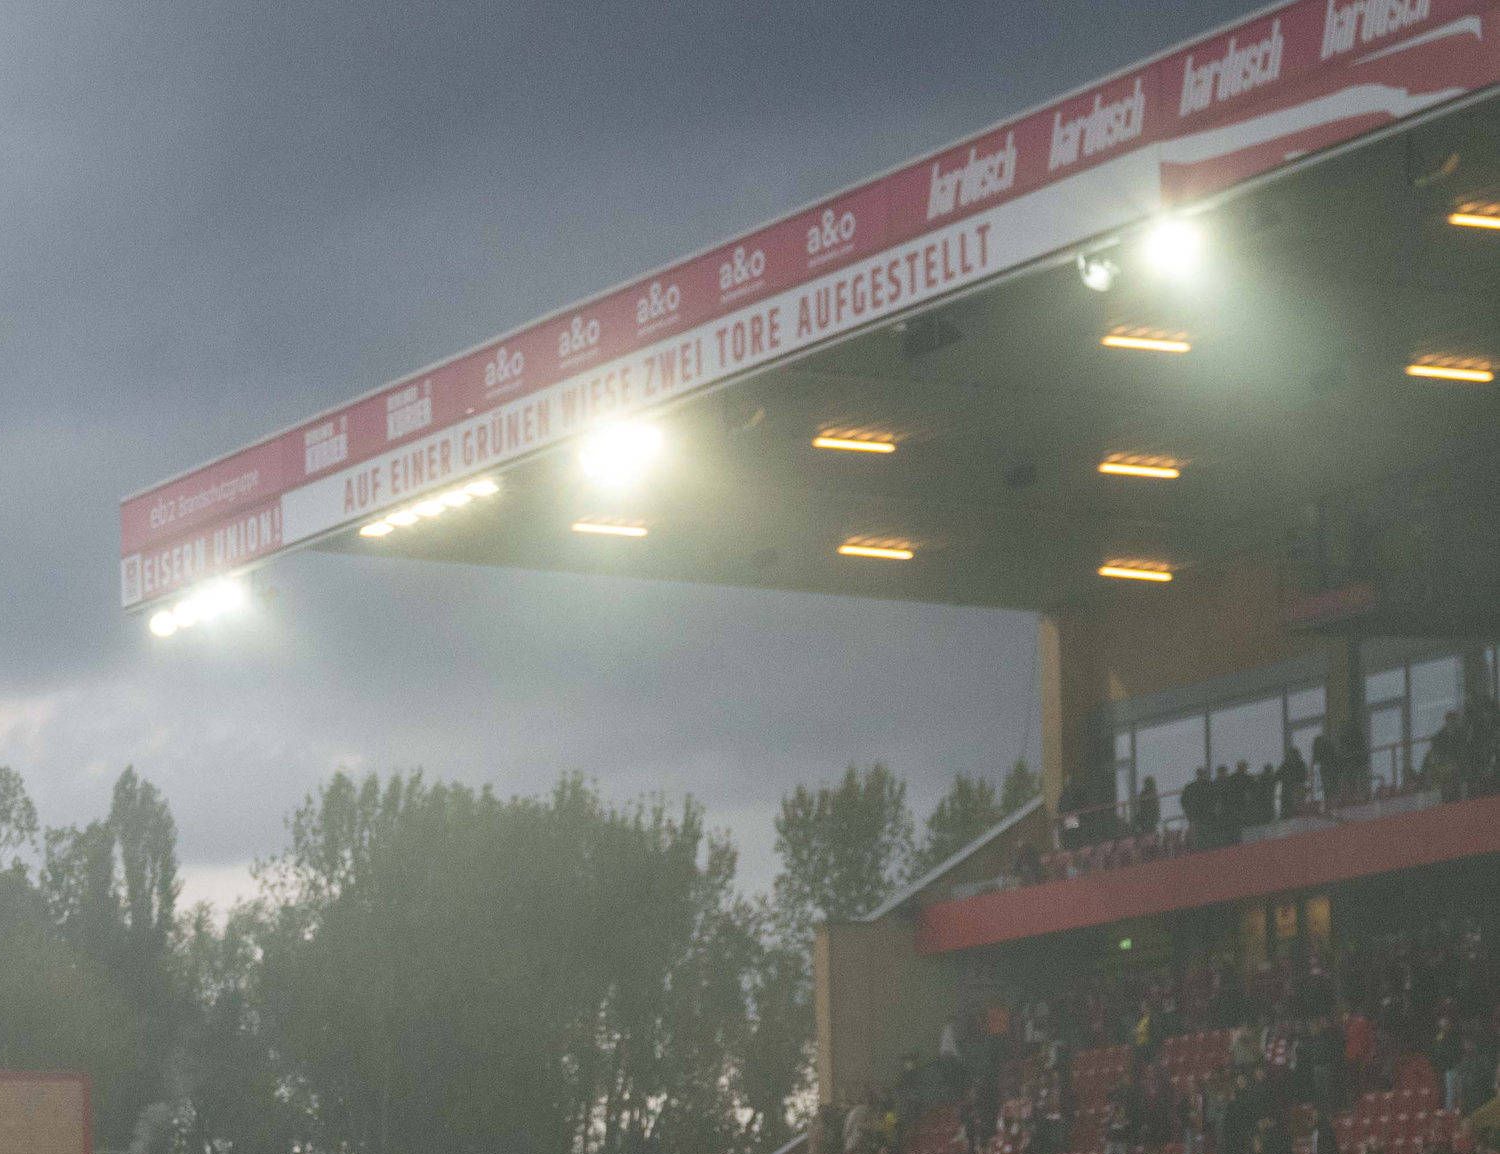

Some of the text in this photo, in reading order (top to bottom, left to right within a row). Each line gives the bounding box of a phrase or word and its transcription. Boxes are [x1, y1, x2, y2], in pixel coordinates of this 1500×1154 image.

[806, 208, 856, 255] a&o
[718, 246, 766, 291] a&o
[636, 282, 681, 326] a&o
[557, 315, 600, 358] a&o
[343, 224, 994, 514] AUF EINER GRÜNEN WIESE ZWEI TORE AUFGESTELLT
[484, 346, 525, 388] a&o
[144, 506, 282, 593] EISERN UNION!
